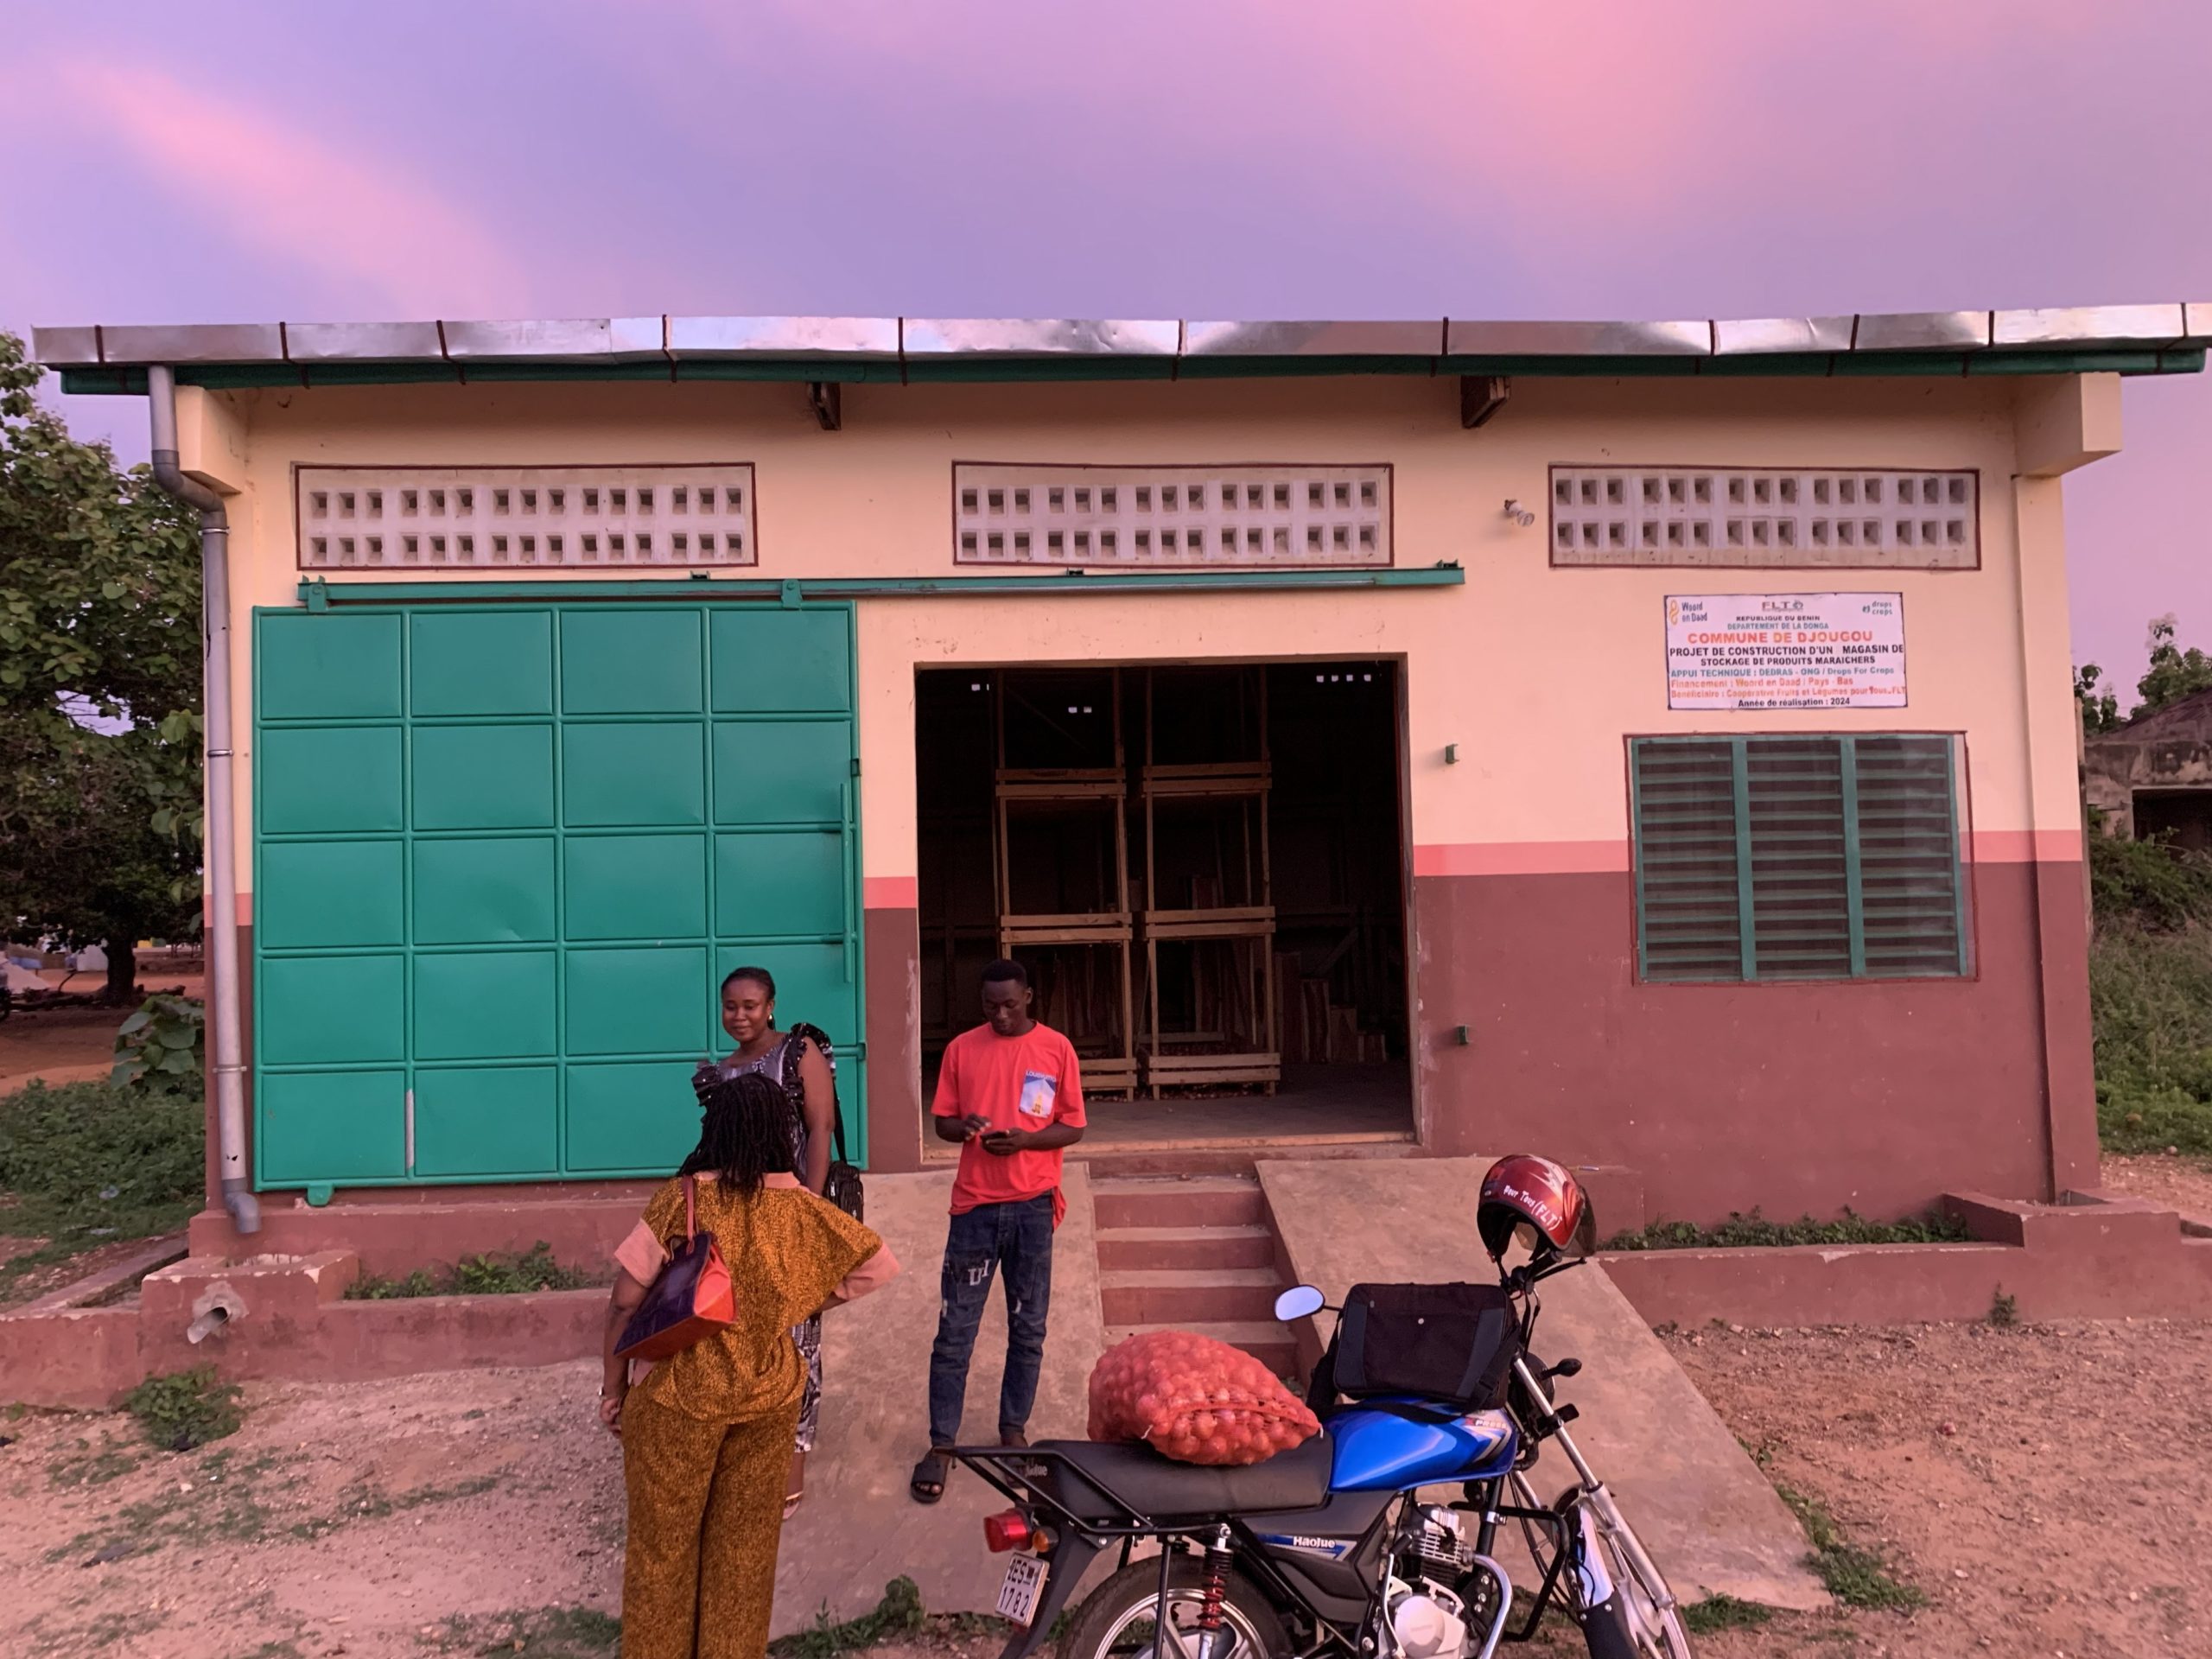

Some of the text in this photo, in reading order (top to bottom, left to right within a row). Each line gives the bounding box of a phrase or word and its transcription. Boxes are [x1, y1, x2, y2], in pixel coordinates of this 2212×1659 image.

[1688, 631, 1872, 644] COMMUNE DE DJOUGOU
[1669, 644, 1904, 657] PROJET DE CONSTRUCTION D'UN MAGASIN DE
[1700, 658, 1750, 666] STOCKAGE
[1767, 657, 1813, 665] PRODUITS
[1815, 655, 1875, 664] MARAICHERS
[1700, 669, 1751, 677] TECHNIQUE
[1870, 666, 1894, 675] Crops
[1671, 679, 1727, 689] Financement
[1837, 677, 1853, 685] Bas
[1738, 698, 1764, 707] Année
[1767, 698, 1777, 707] de
[1830, 697, 1850, 706] 2024
[1000, 1586, 1030, 1618] 1782
